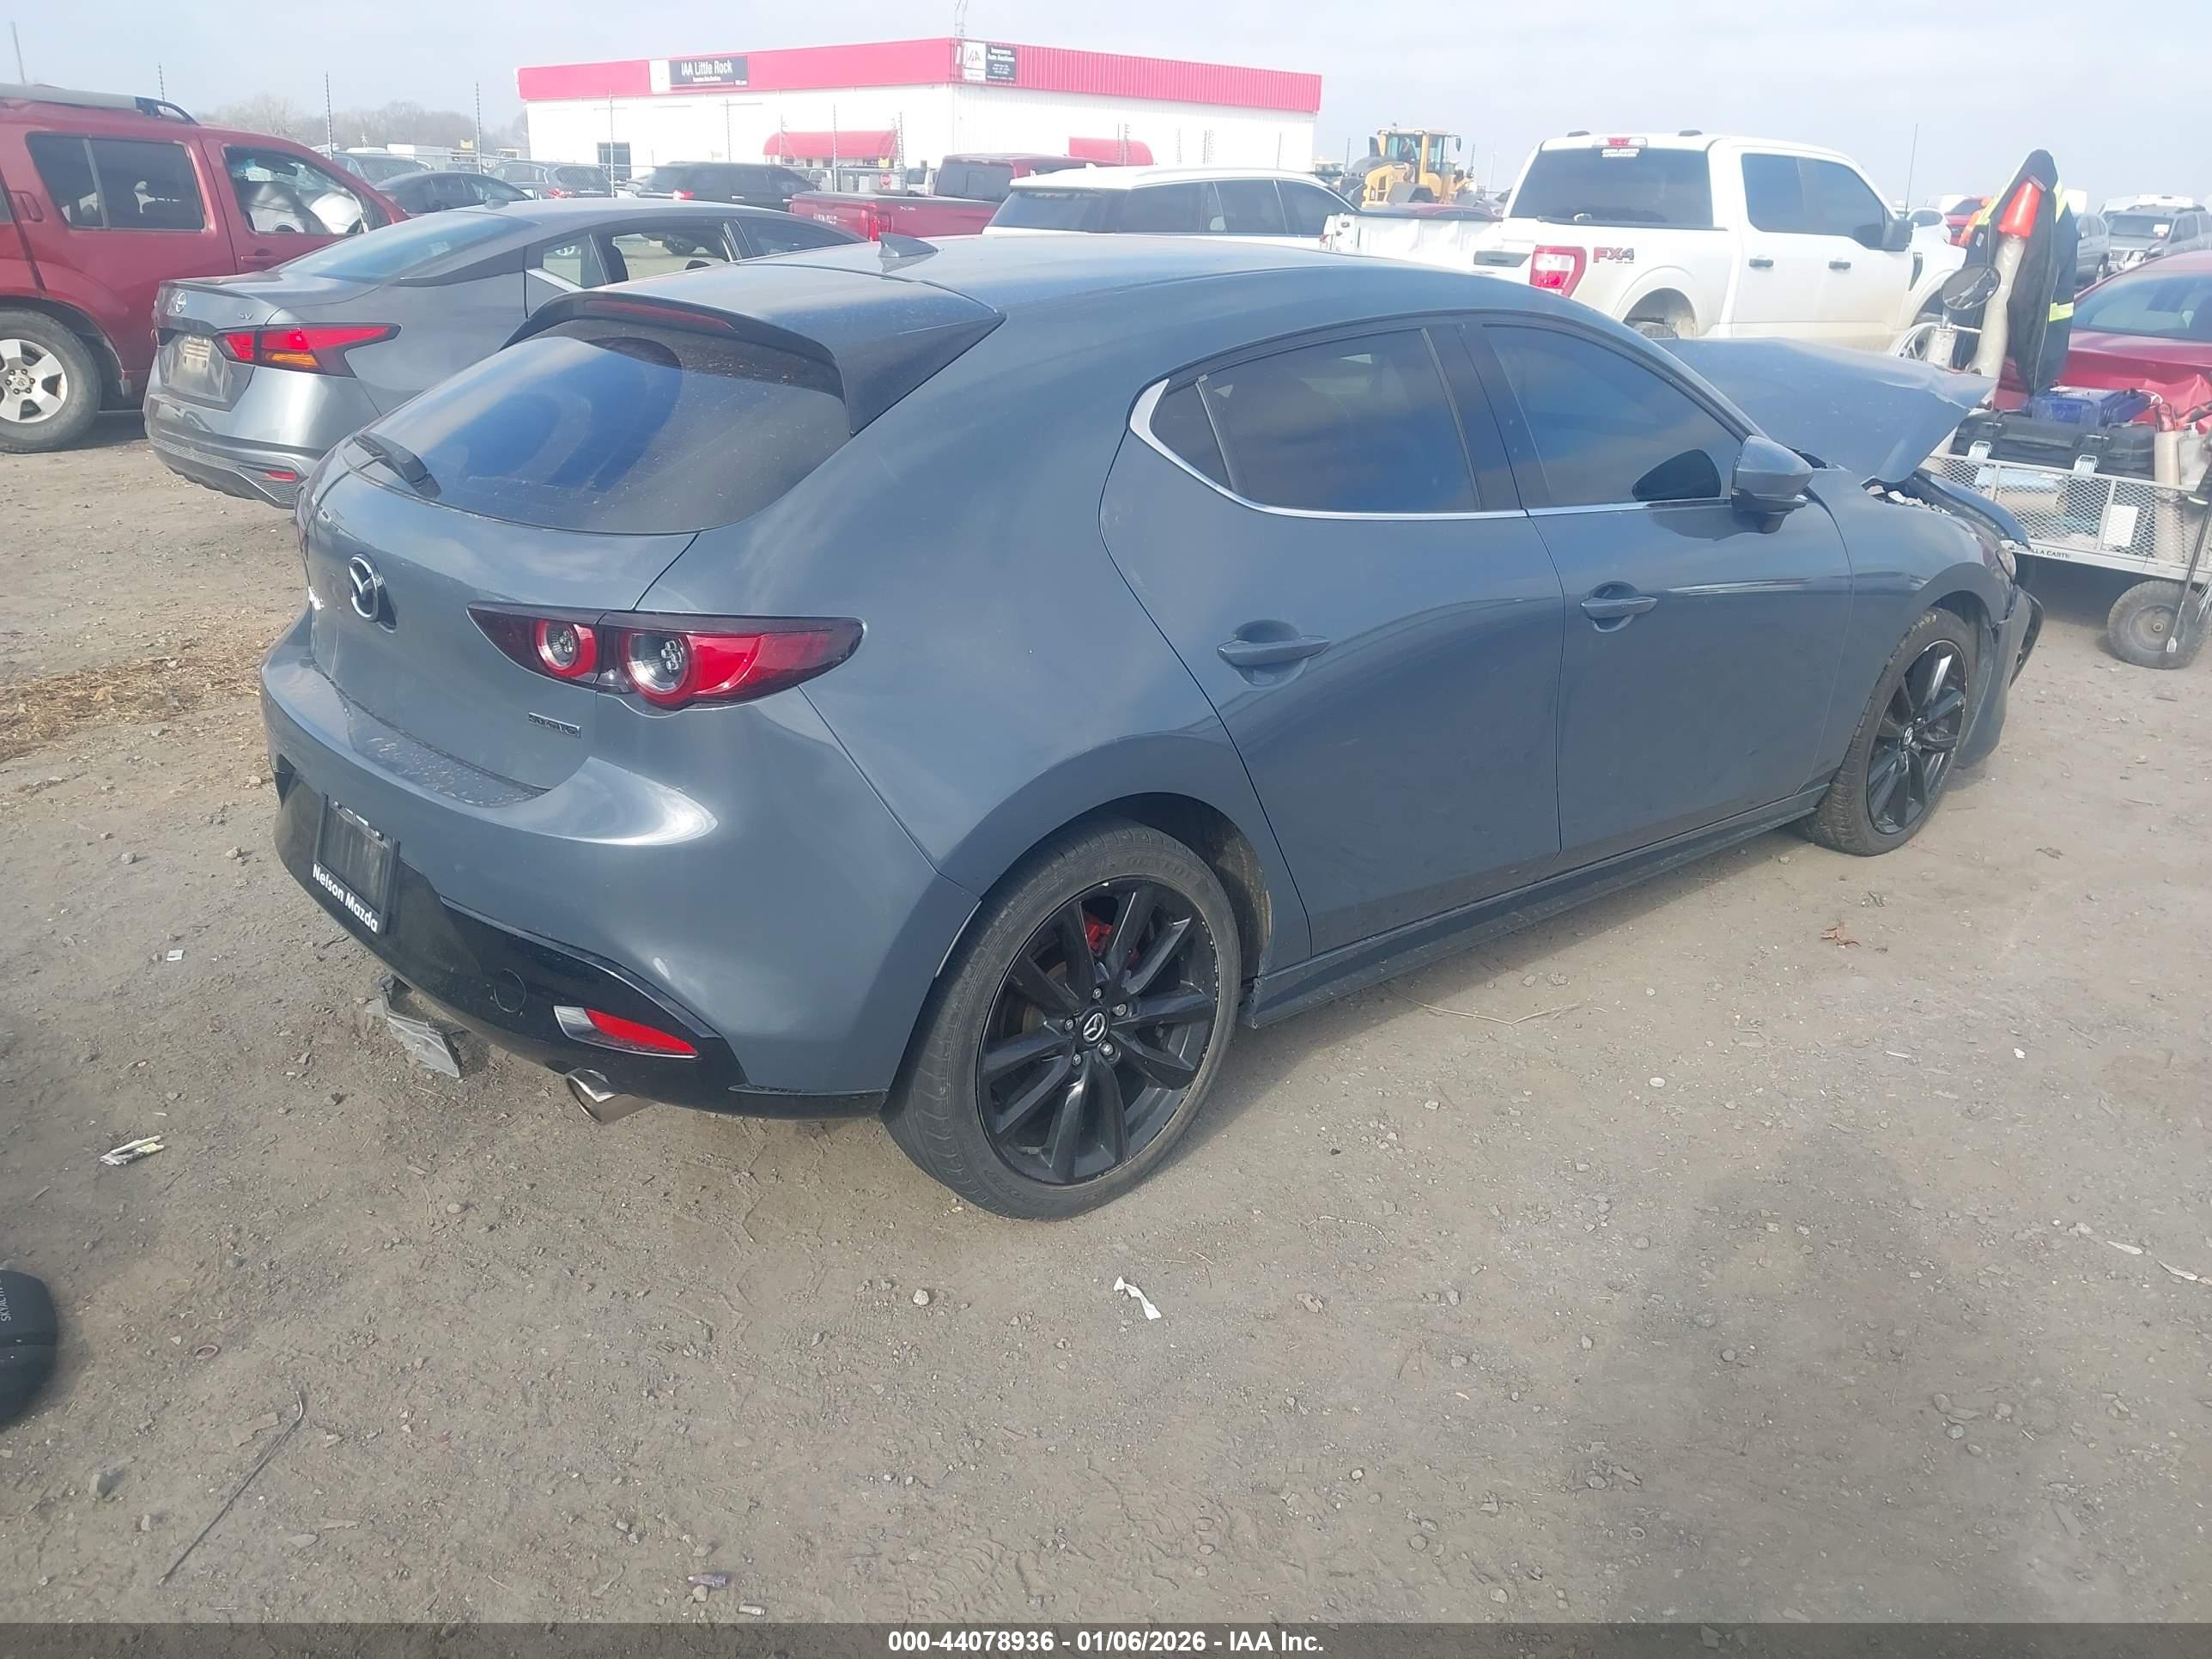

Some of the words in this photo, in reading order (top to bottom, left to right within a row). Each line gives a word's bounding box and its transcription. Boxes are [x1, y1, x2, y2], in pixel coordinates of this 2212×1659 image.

[681, 61, 694, 76] IAA
[695, 60, 713, 76] Little
[714, 59, 733, 75] Rock
[1593, 246, 1635, 264] FX4
[313, 863, 344, 902] Nelson
[344, 891, 379, 933] Mazda
